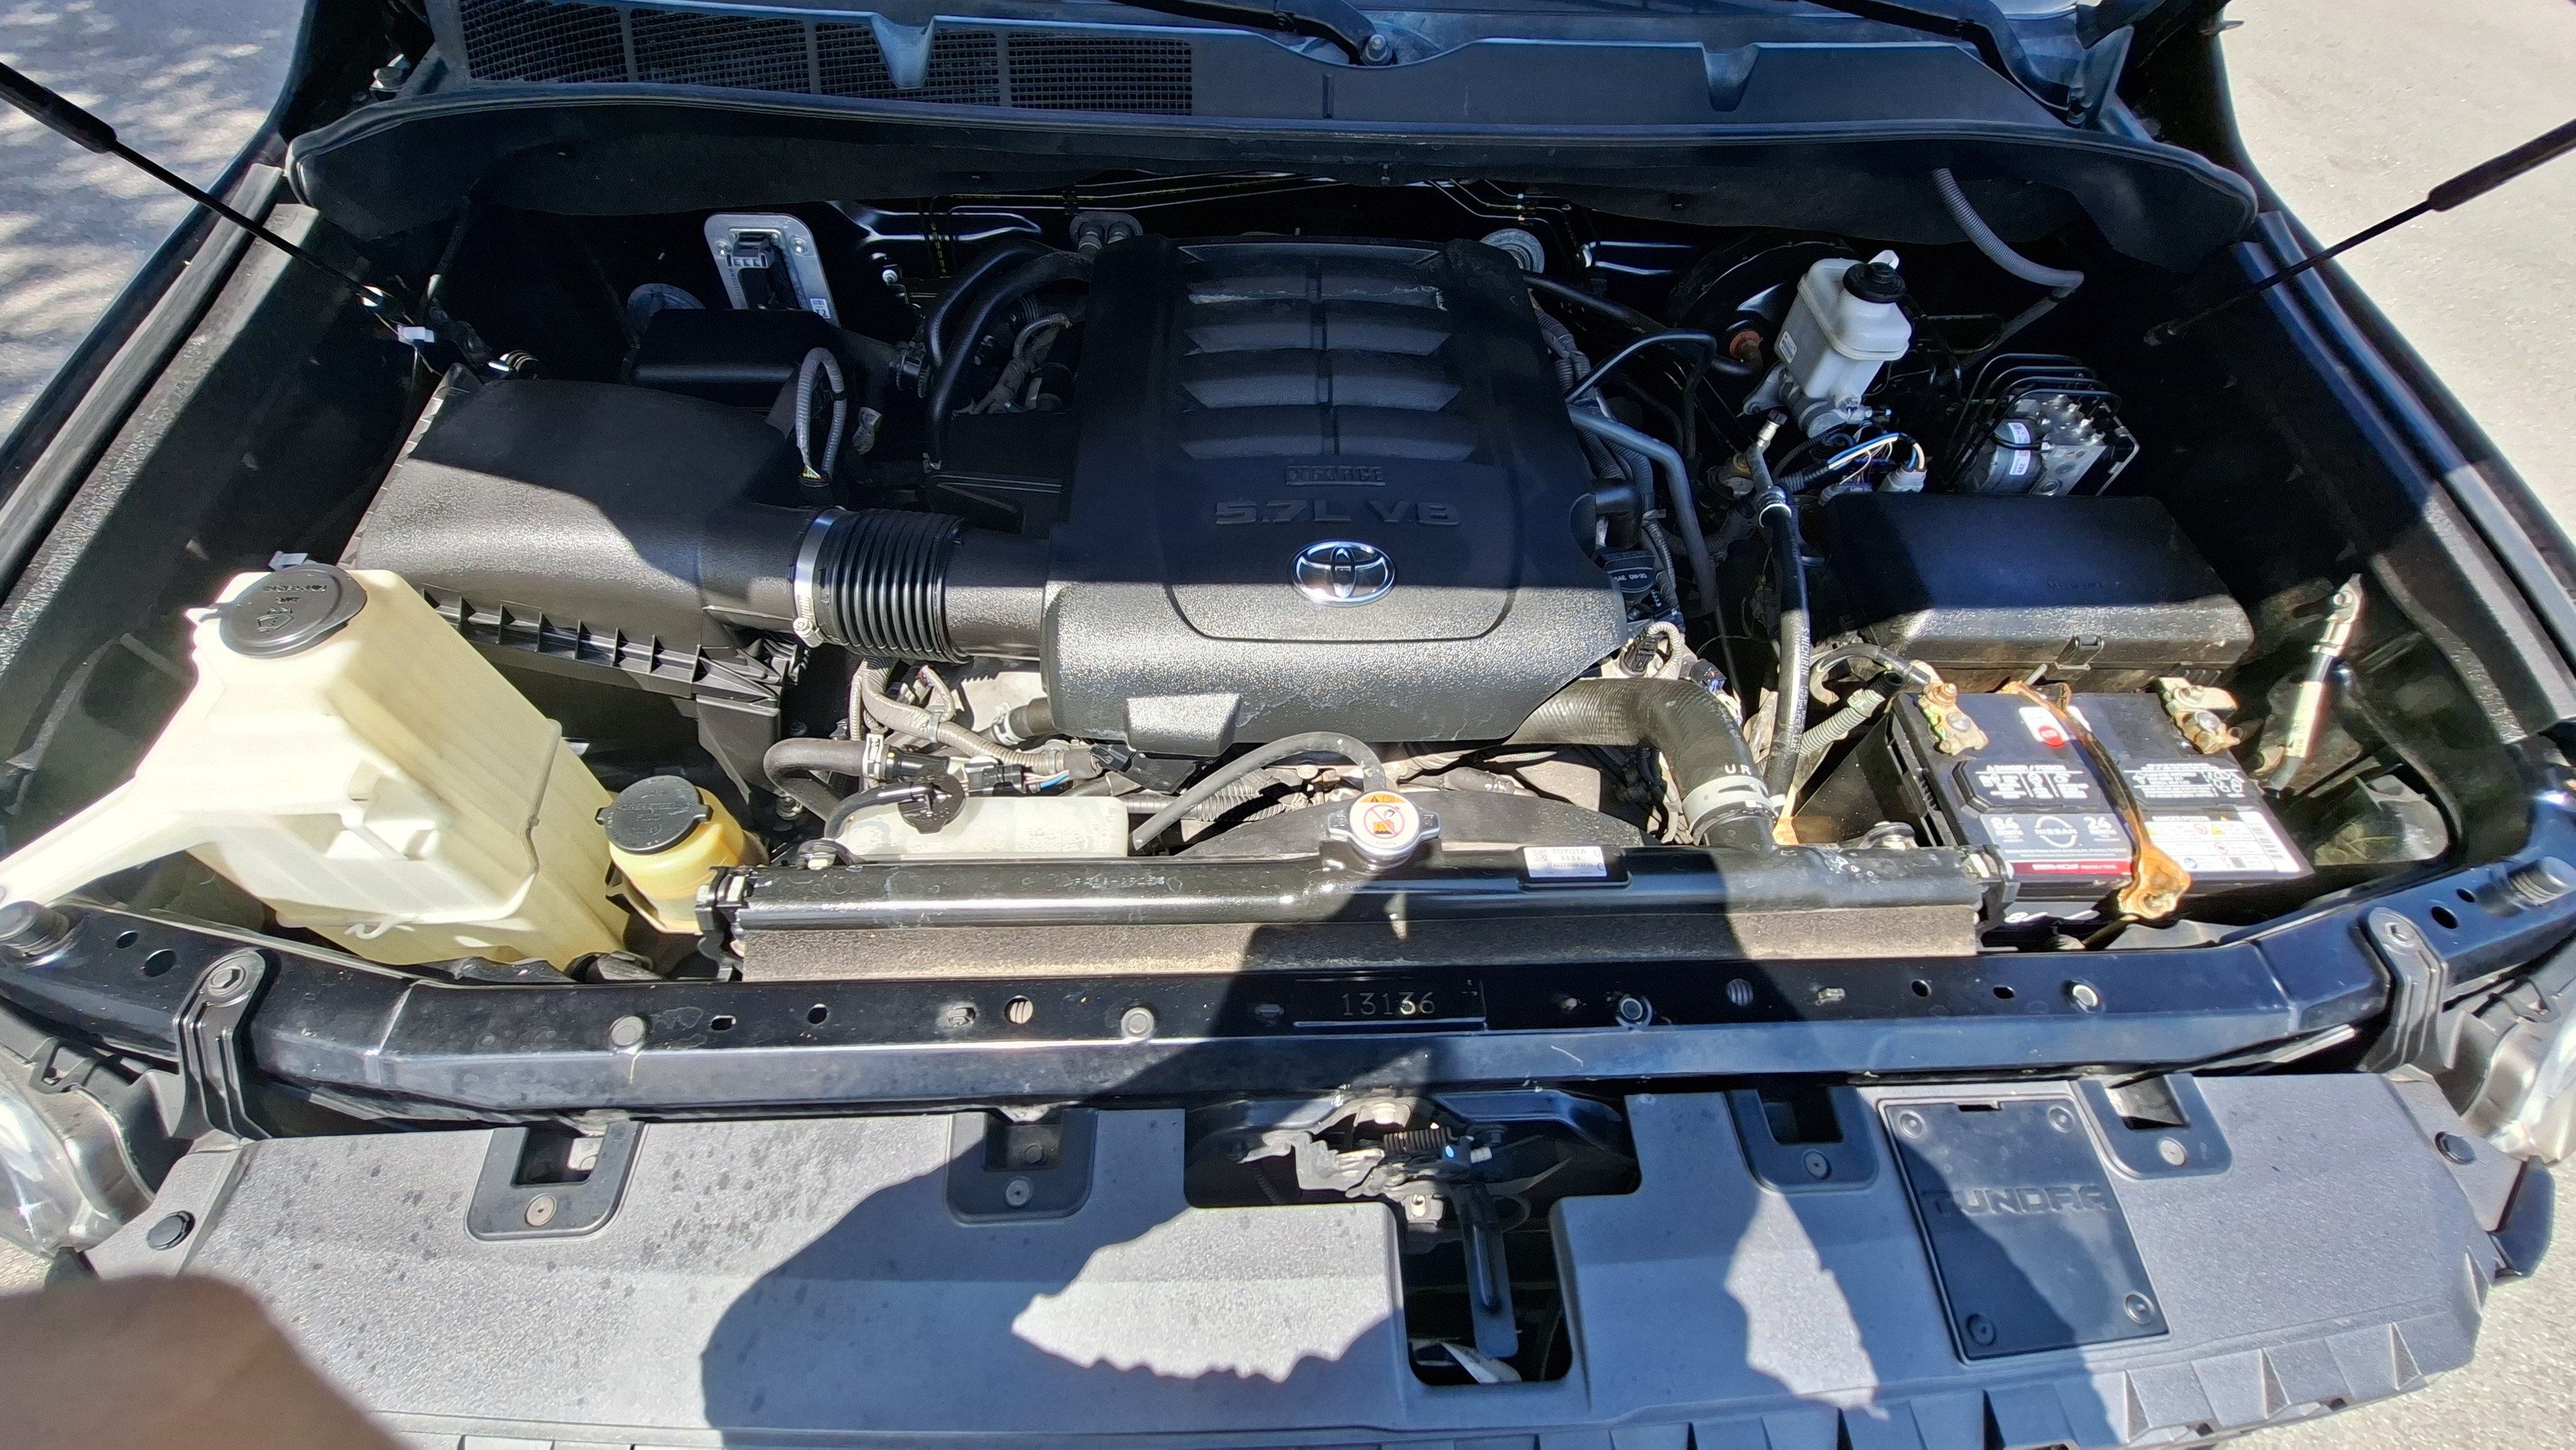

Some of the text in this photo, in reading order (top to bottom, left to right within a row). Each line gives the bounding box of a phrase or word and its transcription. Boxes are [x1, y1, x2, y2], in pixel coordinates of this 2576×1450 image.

[1215, 500, 1459, 525] 5.7L V8
[1990, 816, 2020, 830] 84
[2083, 816, 2112, 829] 24
[1341, 991, 1436, 1016] 13136
[1922, 1185, 2110, 1215] TUNDRA
